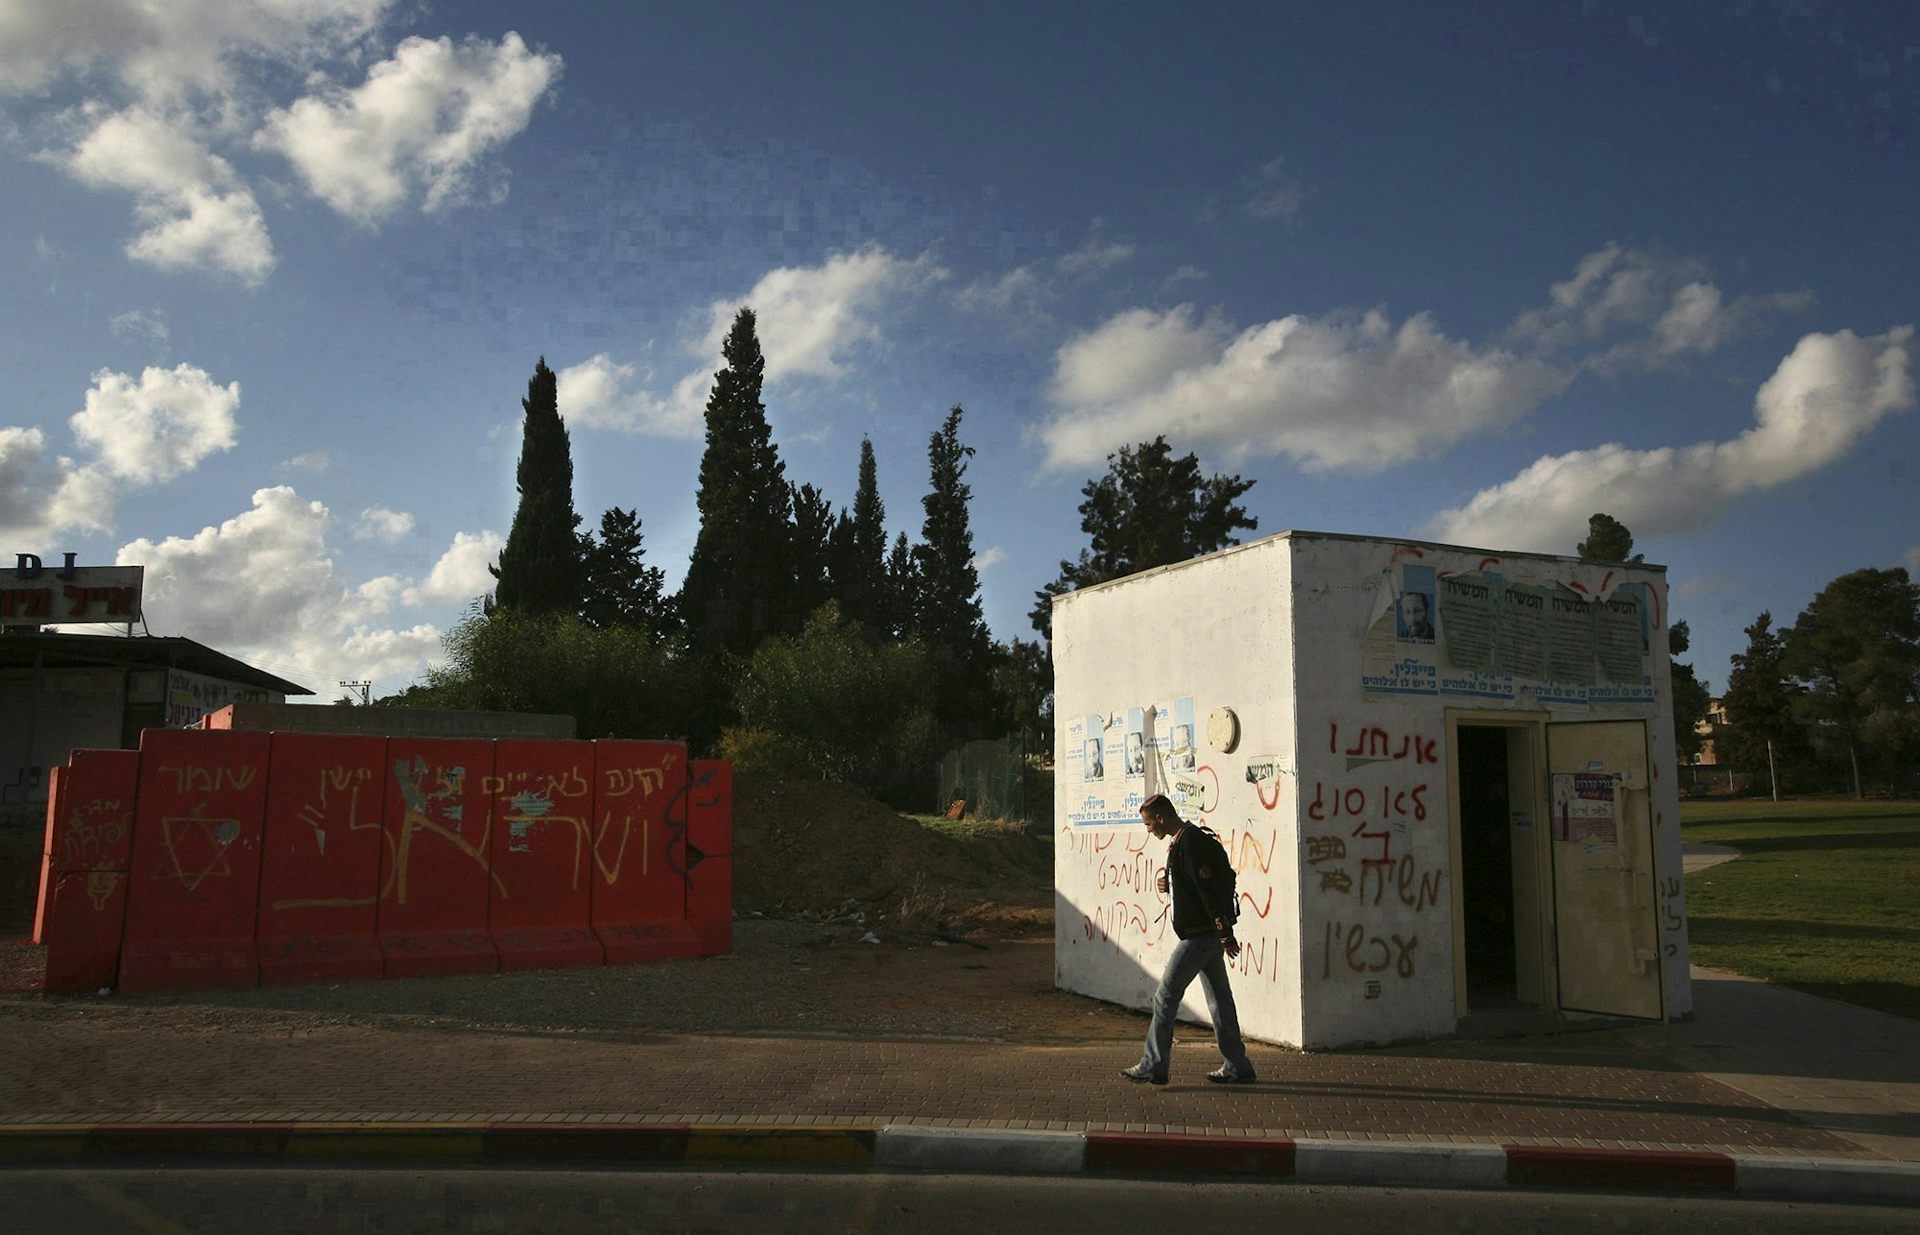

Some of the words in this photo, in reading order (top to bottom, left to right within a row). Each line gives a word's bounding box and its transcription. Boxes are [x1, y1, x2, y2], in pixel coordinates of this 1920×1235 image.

[1504, 587, 1544, 610] המשיח
[1552, 596, 1590, 615] המשיח
[158, 766, 257, 796] שומר
[546, 766, 588, 800] לא
[1360, 855, 1442, 912] משיח
